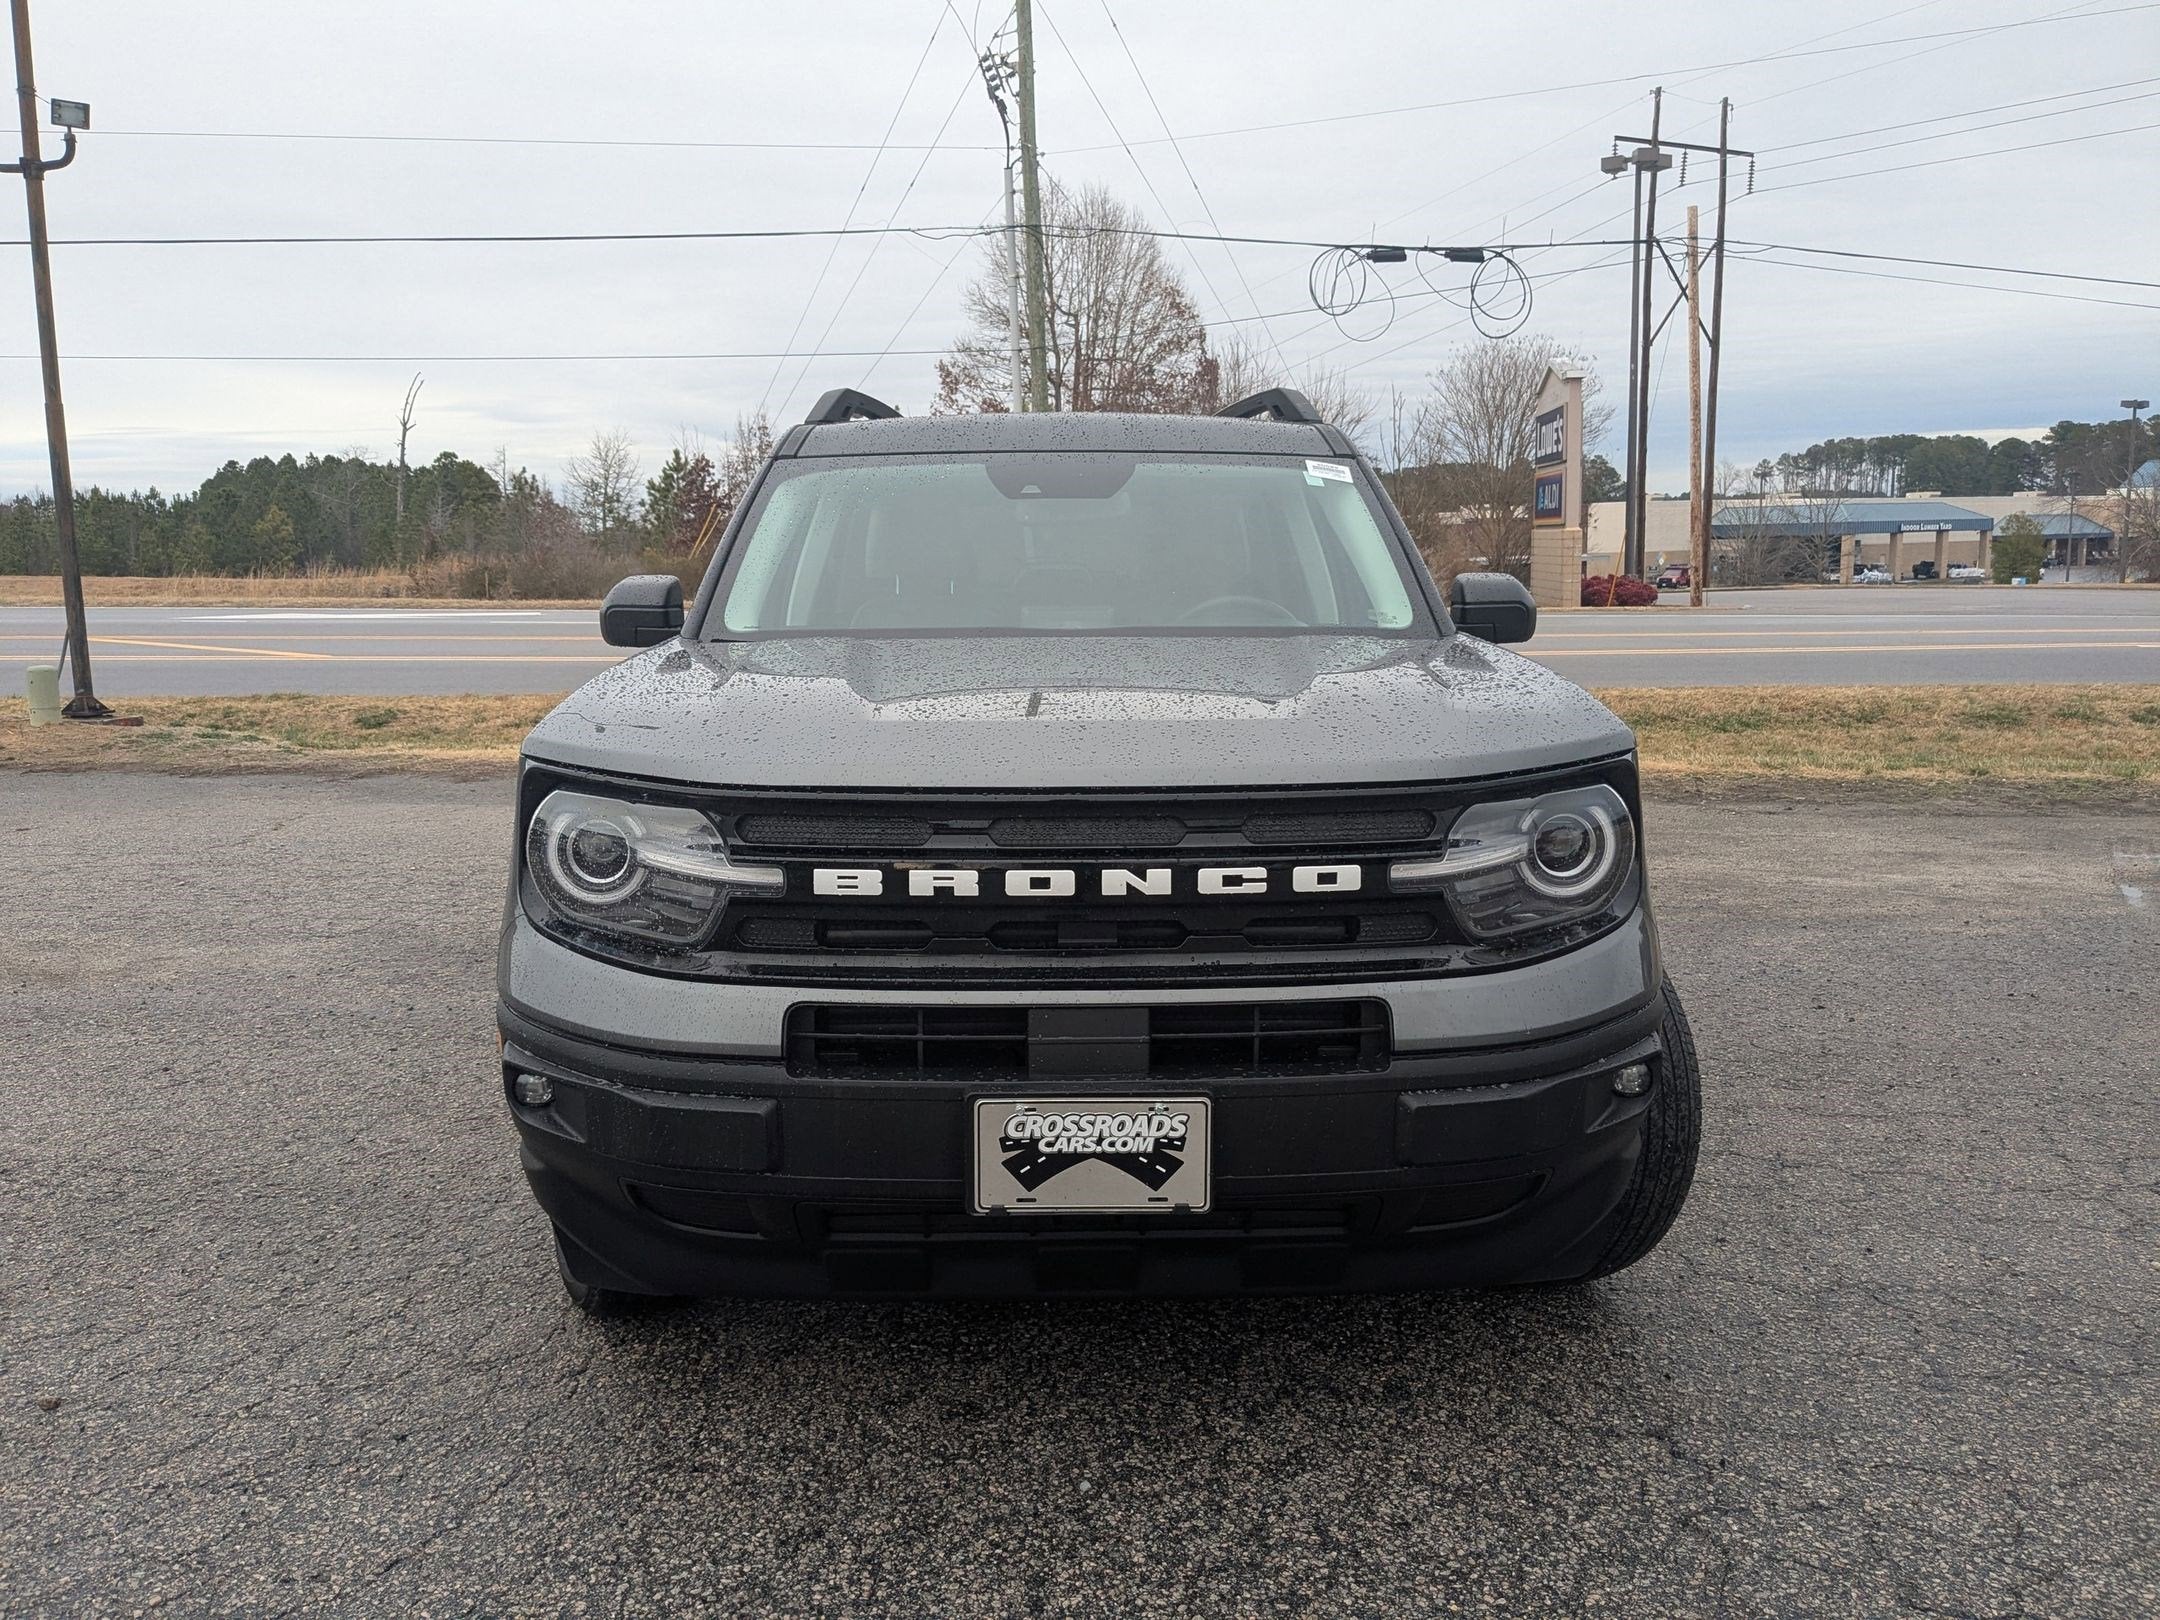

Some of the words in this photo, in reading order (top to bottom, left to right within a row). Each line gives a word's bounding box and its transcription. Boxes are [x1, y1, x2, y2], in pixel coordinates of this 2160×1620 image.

[1537, 414, 1563, 457] LOWE'S
[1544, 484, 1559, 509] ALDI
[1940, 522, 1952, 530] YARD
[813, 864, 1362, 896] BRONCO
[1004, 1113, 1190, 1138] CROSSROADS
[1037, 1136, 1155, 1154] CARS.COM
